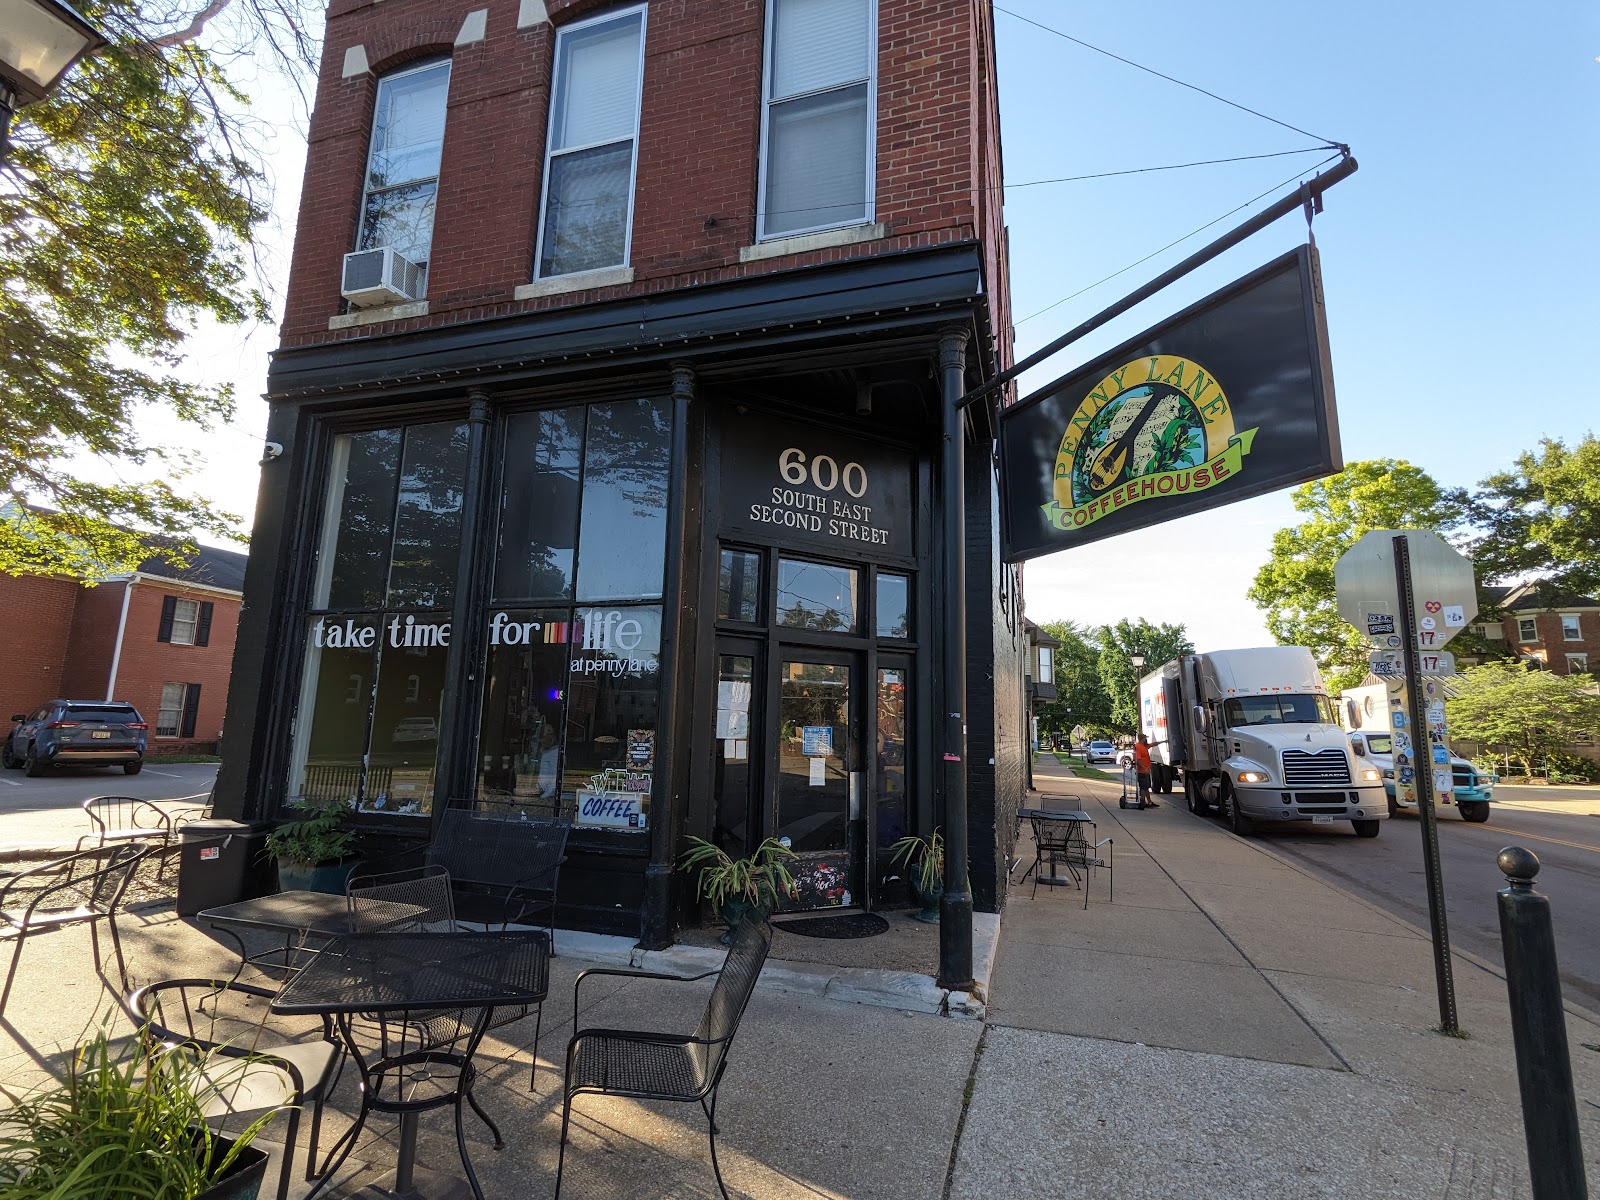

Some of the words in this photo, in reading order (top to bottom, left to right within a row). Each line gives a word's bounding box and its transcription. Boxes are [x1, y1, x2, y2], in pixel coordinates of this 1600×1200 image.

[1055, 366, 1128, 481] PENNY
[1145, 357, 1228, 425] LANE
[778, 447, 868, 498] 600
[771, 486, 827, 514] SOUTH
[832, 499, 872, 523] EAST
[1059, 457, 1231, 528] COFFEEHOUSE
[750, 504, 822, 532] SECOND
[829, 519, 889, 545] STREET
[313, 615, 376, 648] take
[387, 614, 451, 648] time
[489, 611, 541, 645] for
[581, 608, 643, 650] life
[1420, 631, 1435, 645] 17
[570, 656, 584, 672] at
[584, 659, 629, 677] penny
[628, 653, 659, 672] lane
[1423, 656, 1438, 670] 17
[582, 797, 637, 818] COFFEE
